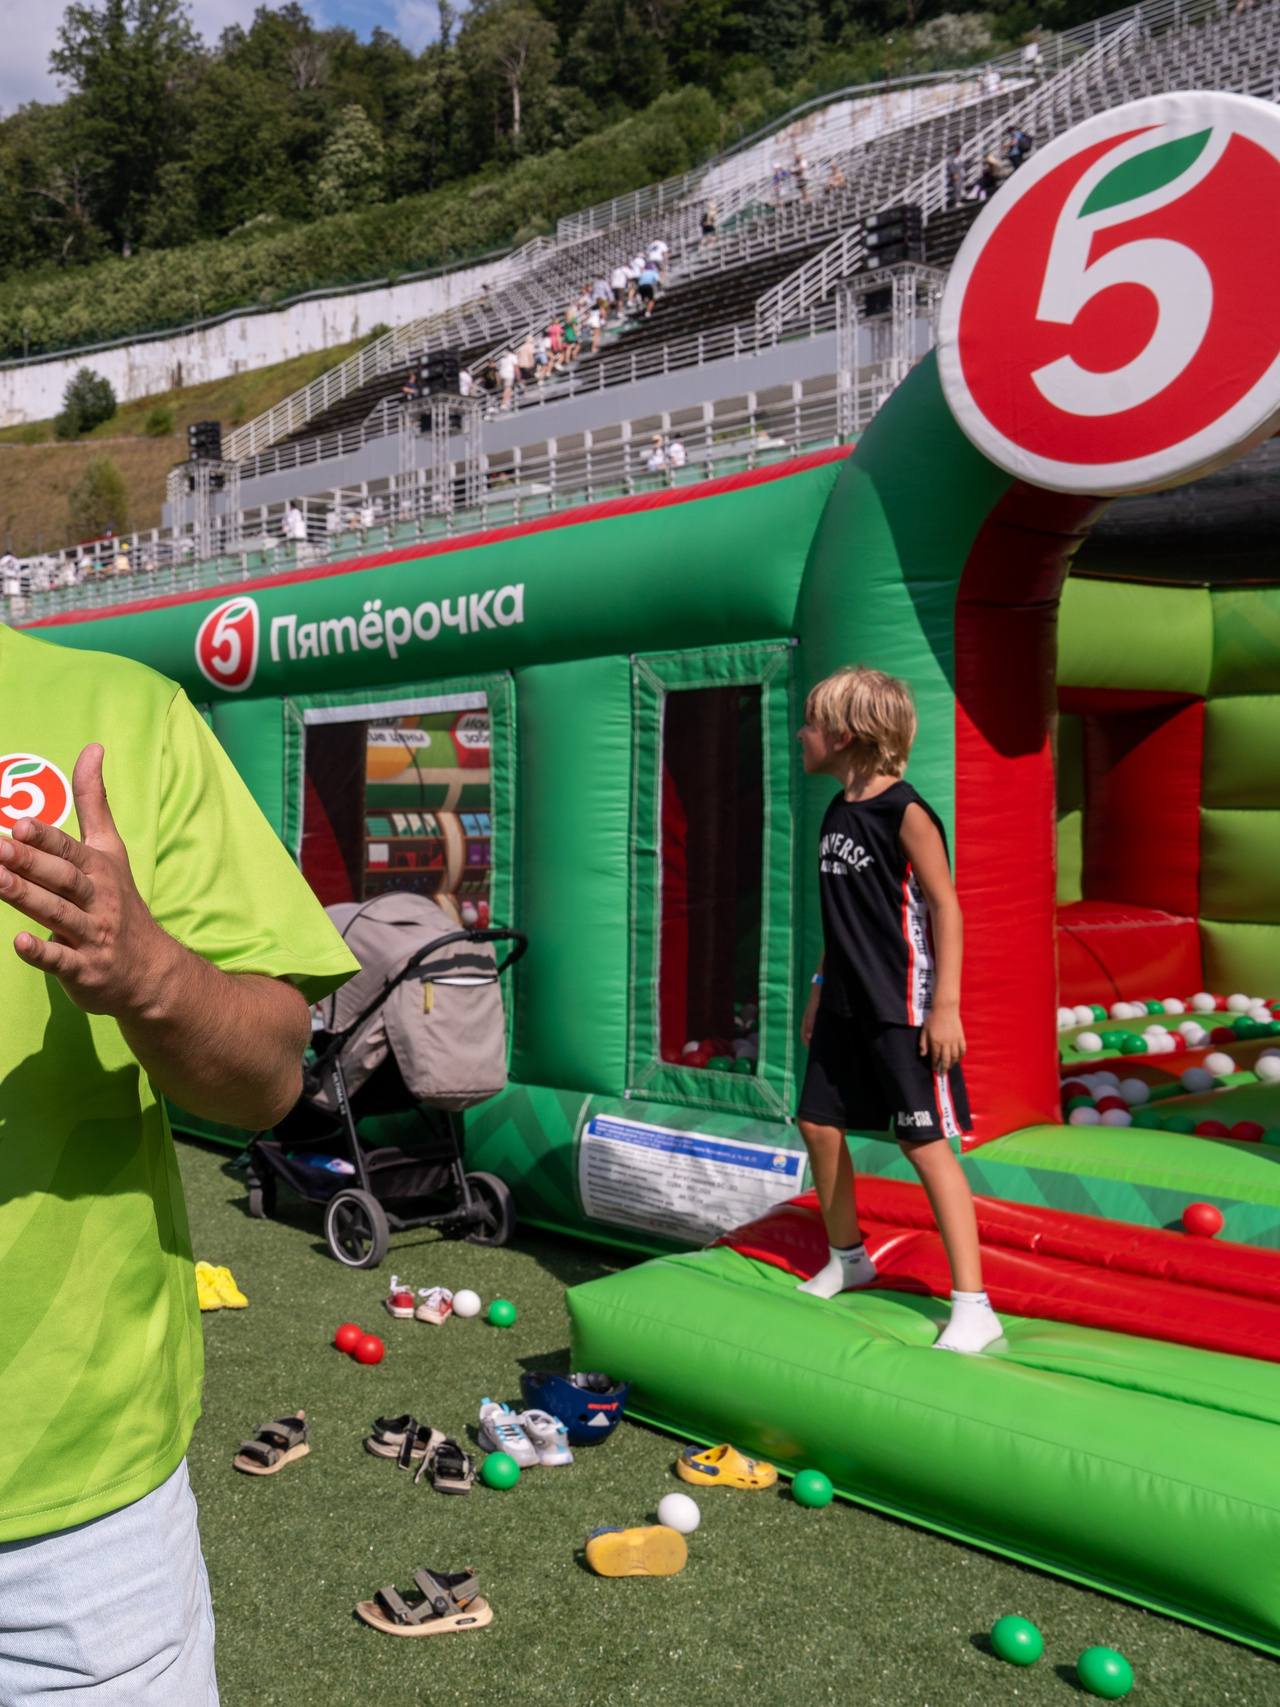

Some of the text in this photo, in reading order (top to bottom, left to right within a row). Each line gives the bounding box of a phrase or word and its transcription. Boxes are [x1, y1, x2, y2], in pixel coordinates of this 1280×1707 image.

[1030, 124, 1232, 417] 5
[210, 582, 525, 676] 5 Пятёрочка
[0, 758, 47, 820] 5
[819, 832, 875, 873] NVERSE
